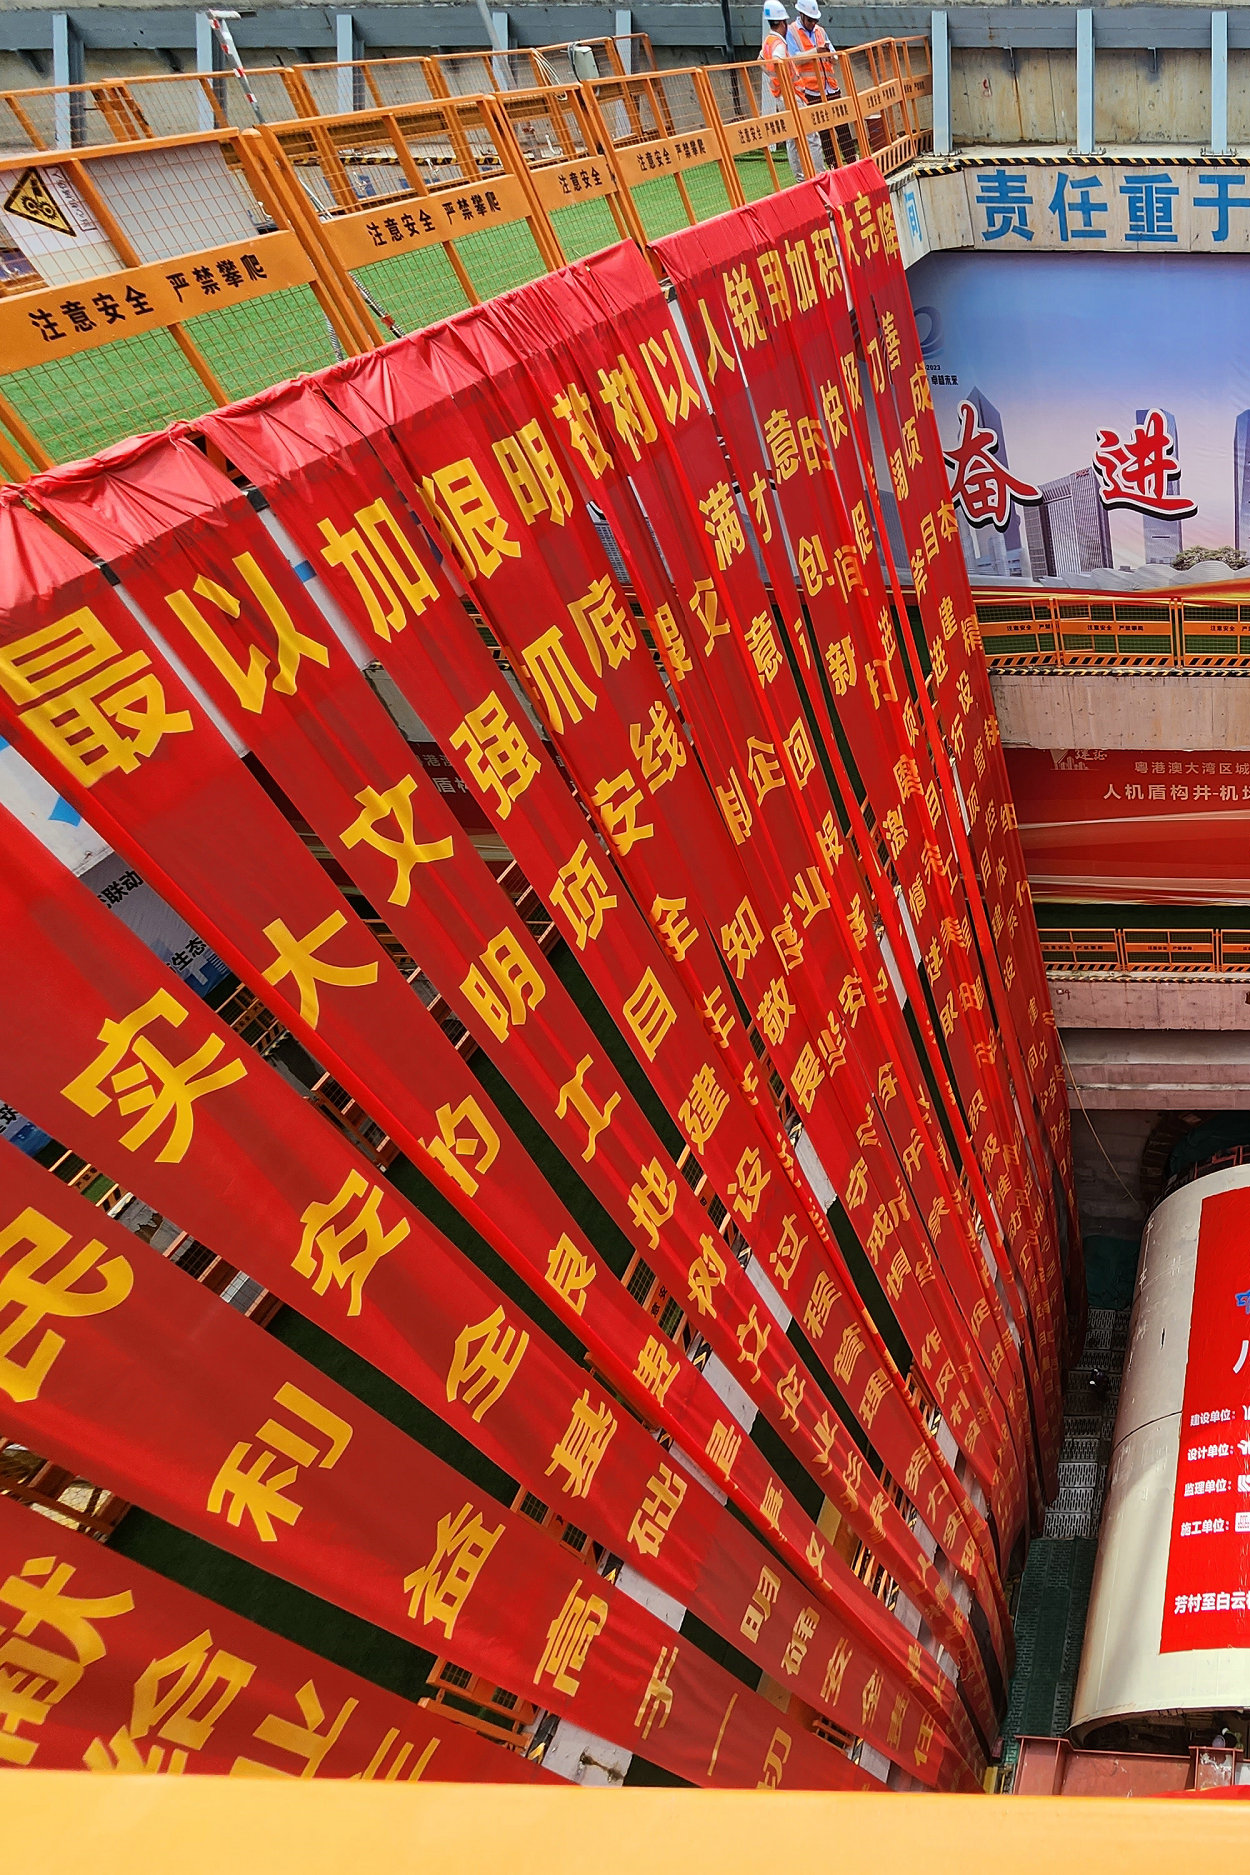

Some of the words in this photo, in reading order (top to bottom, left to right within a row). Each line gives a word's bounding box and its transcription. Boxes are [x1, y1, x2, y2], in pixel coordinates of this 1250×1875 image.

[558, 167, 603, 195] 注意安全
[636, 147, 673, 172] 注意安全
[366, 209, 437, 248] 注意安全
[443, 190, 502, 226] 严禁攀爬
[28, 285, 155, 343] 注意安全
[166, 253, 269, 303] 严禁攀爬
[723, 264, 856, 695] 锐意创新
